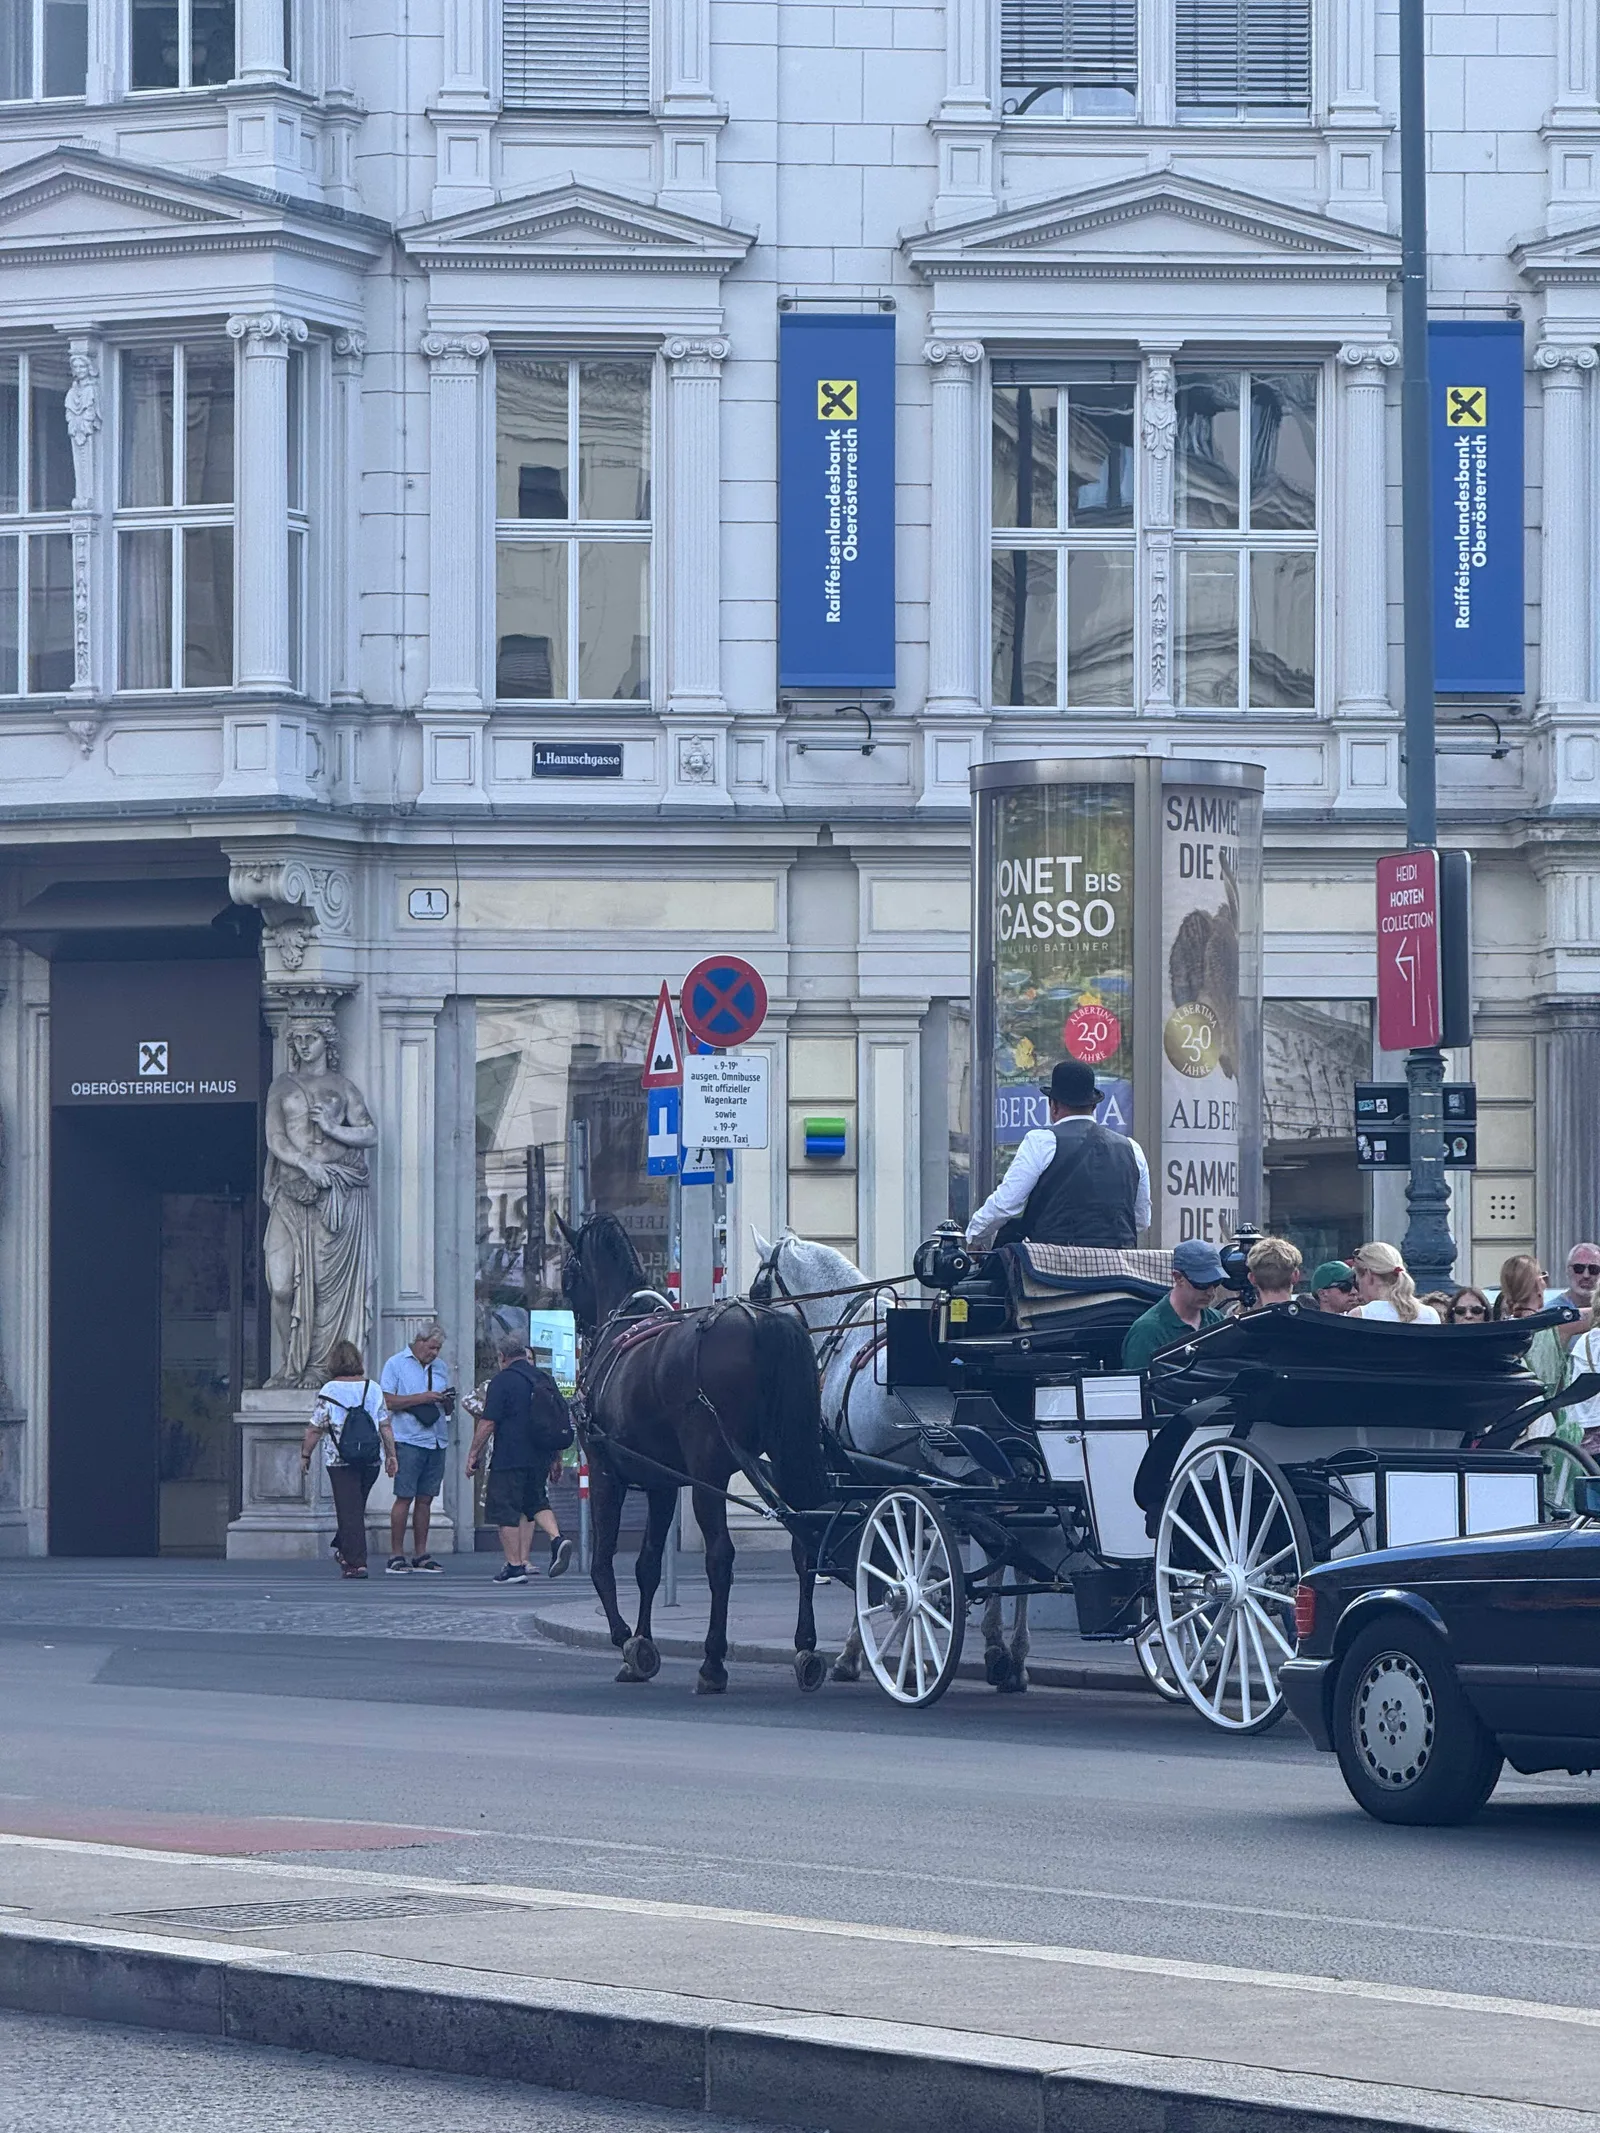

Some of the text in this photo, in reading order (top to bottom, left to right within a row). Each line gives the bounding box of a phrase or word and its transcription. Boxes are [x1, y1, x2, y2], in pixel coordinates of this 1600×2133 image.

[842, 427, 858, 562] Oberösterreich
[1471, 434, 1487, 567] Oberösterreich
[825, 428, 840, 622] Raiffeisenlandesbank
[1454, 435, 1470, 628] Raiffeisenlandesbank
[1180, 843, 1214, 880] DIE
[997, 856, 1122, 898] ONET BIS
[1396, 864, 1417, 882] HEIDI
[1390, 888, 1424, 908] HORTEN
[1382, 911, 1434, 933] COLLECTION
[1044, 942, 1109, 953] BATLINER
[1069, 1006, 1115, 1025] ALBERTINA
[1172, 1003, 1218, 1029] ALBERTINA
[1078, 1022, 1108, 1051] 250
[1181, 1024, 1212, 1062] 250
[1078, 1050, 1107, 1063] JAHRE
[691, 1072, 761, 1082] ausgen. Omnibusse
[1181, 1063, 1211, 1077] JAHRE
[71, 1080, 237, 1096] OBERÖSTERREICH HAUS
[700, 1084, 751, 1093] mit offizieller
[704, 1096, 748, 1106] Wagenkarte
[715, 1109, 737, 1119] sowie
[702, 1134, 749, 1144] ausgen. Taxi
[1180, 1207, 1213, 1244] DIE
